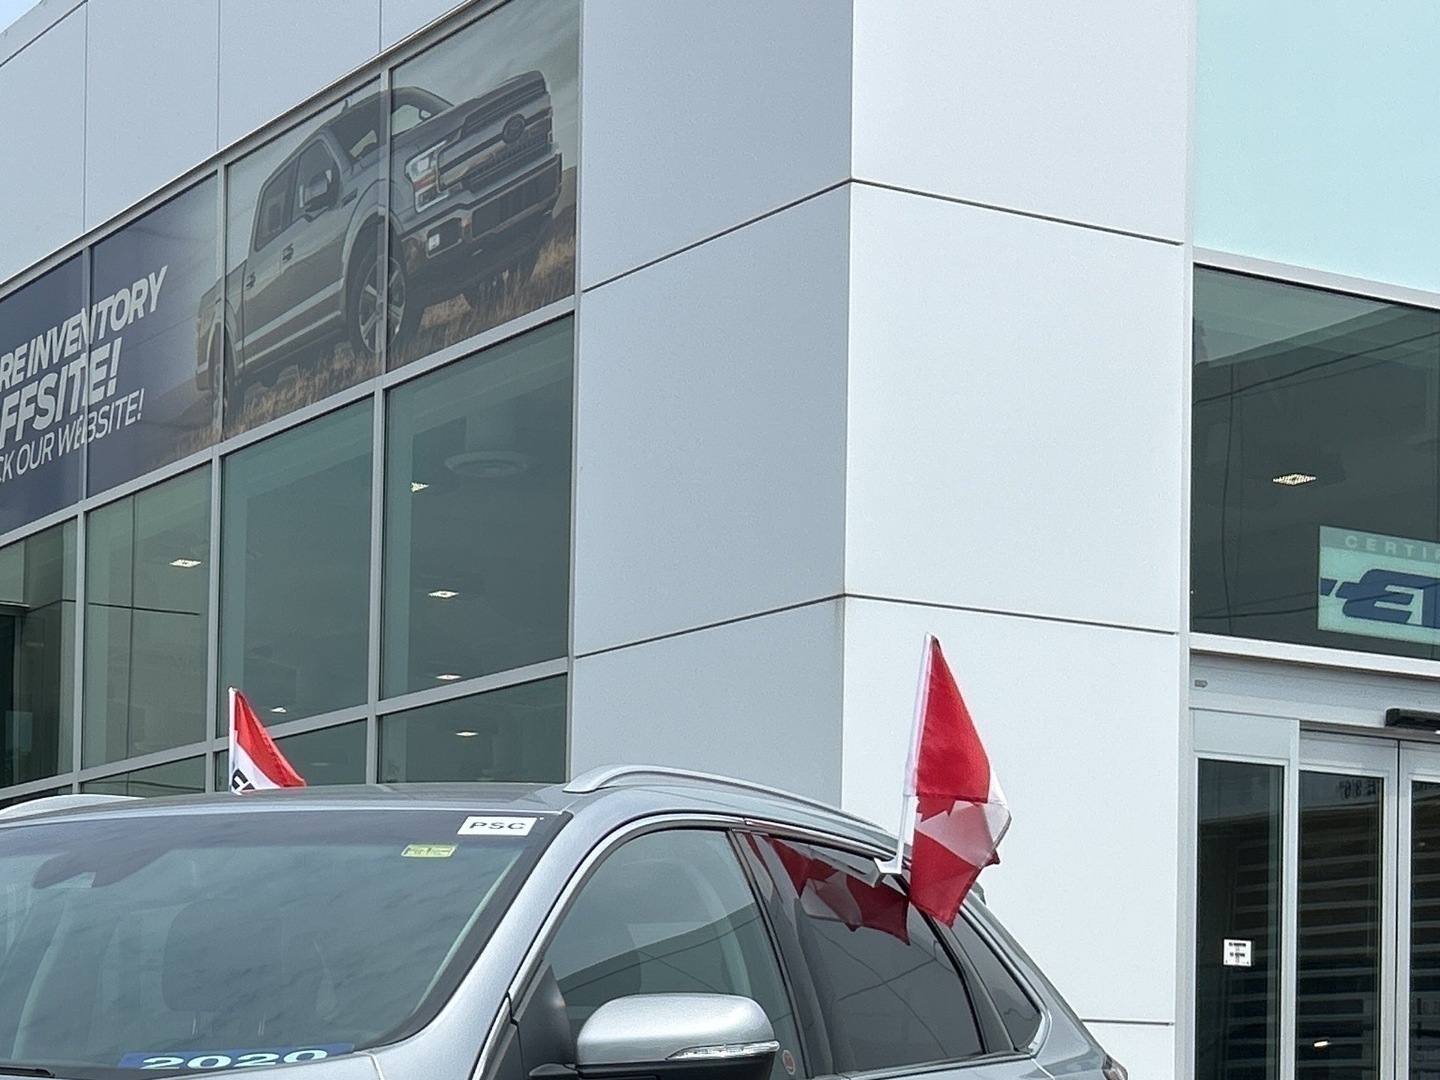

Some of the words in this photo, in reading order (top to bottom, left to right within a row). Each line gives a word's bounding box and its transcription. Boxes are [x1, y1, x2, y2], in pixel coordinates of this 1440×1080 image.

[27, 264, 168, 378] INVENTORY
[16, 432, 54, 476] OUR
[58, 388, 144, 457] WEBSITE!
[469, 822, 527, 830] PSC
[140, 1049, 328, 1070] 2020
